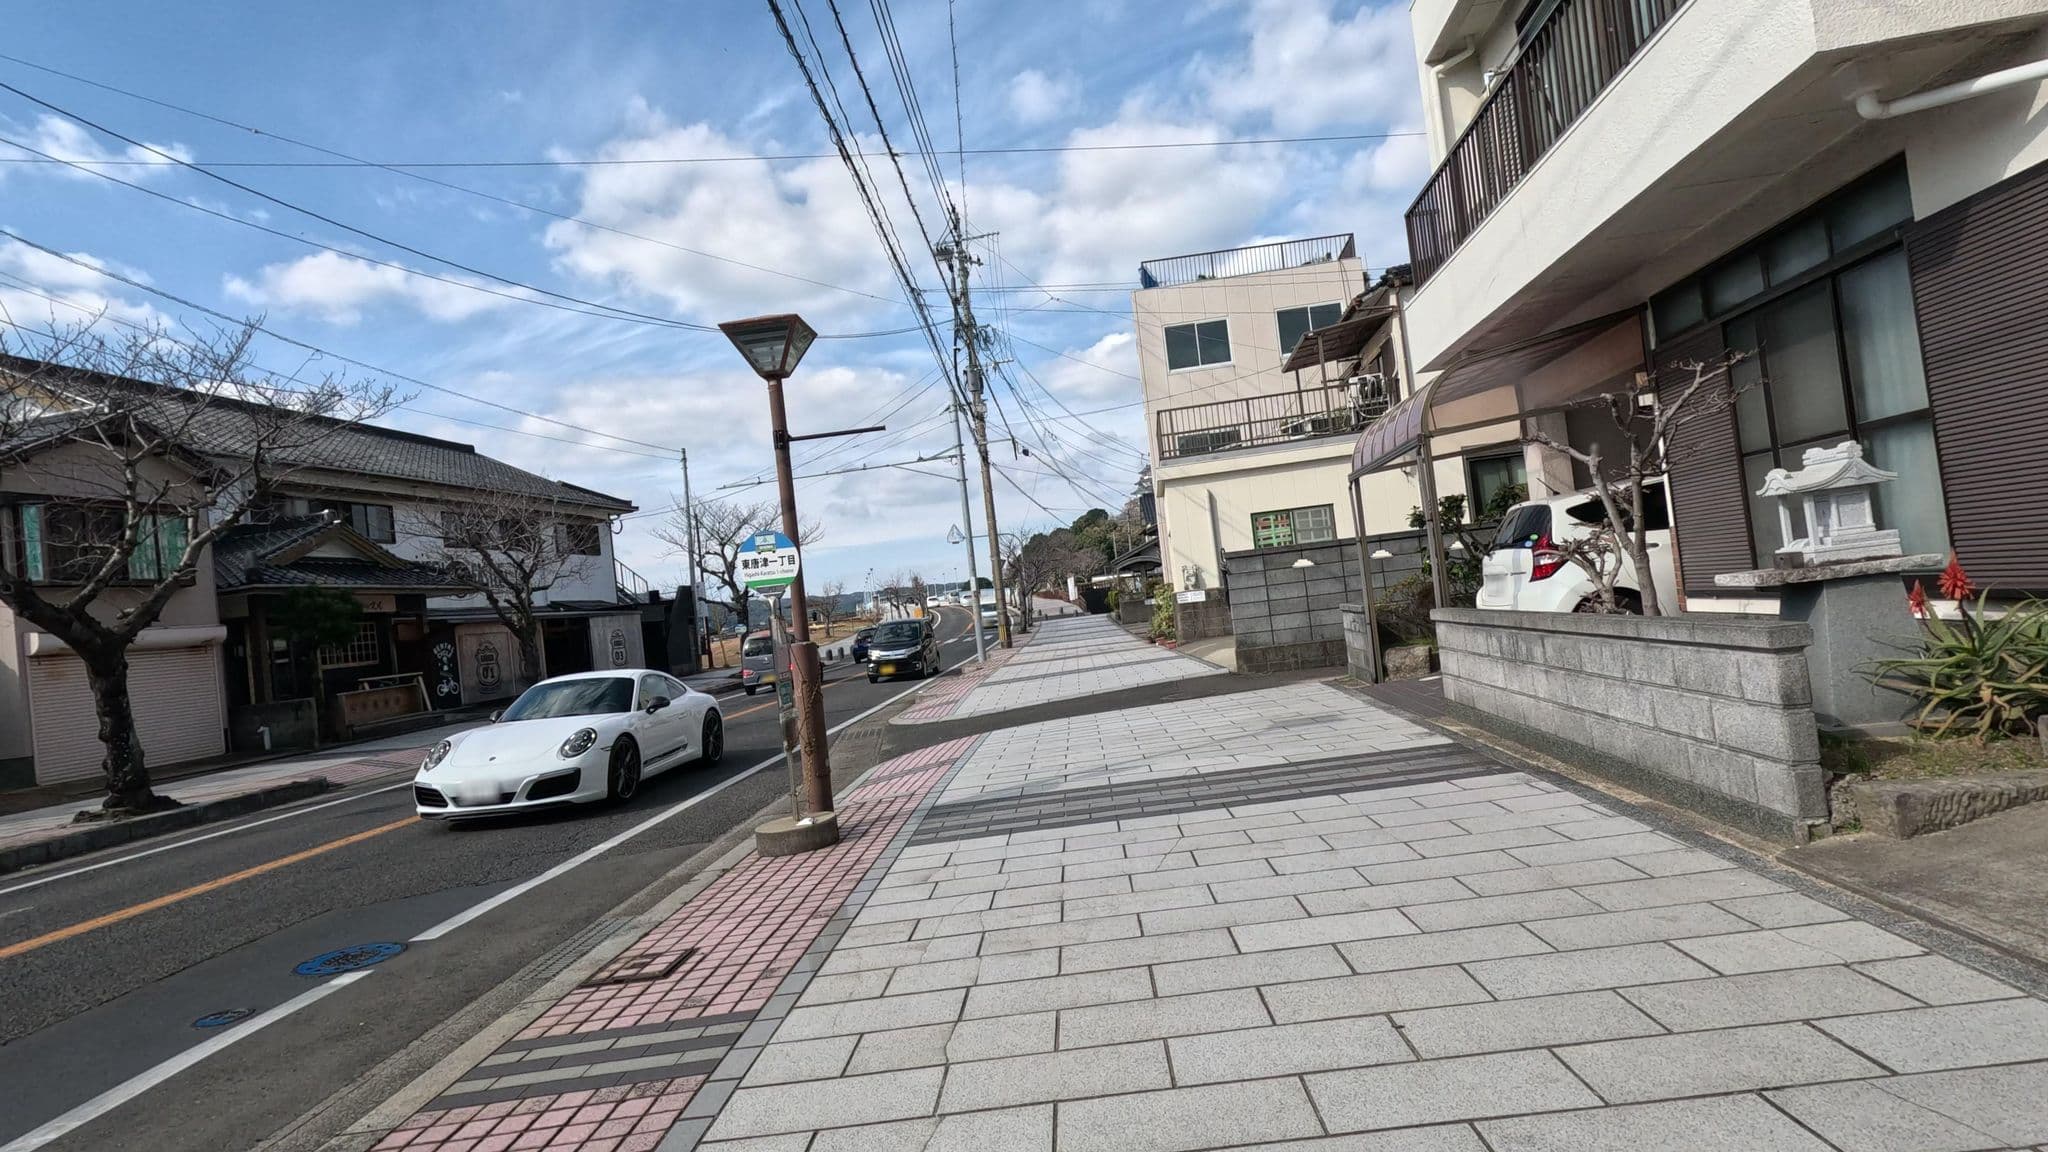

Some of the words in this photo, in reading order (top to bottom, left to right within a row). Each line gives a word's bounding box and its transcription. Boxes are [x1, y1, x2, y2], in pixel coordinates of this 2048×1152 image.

[741, 554, 796, 570] 東唐津一丁目
